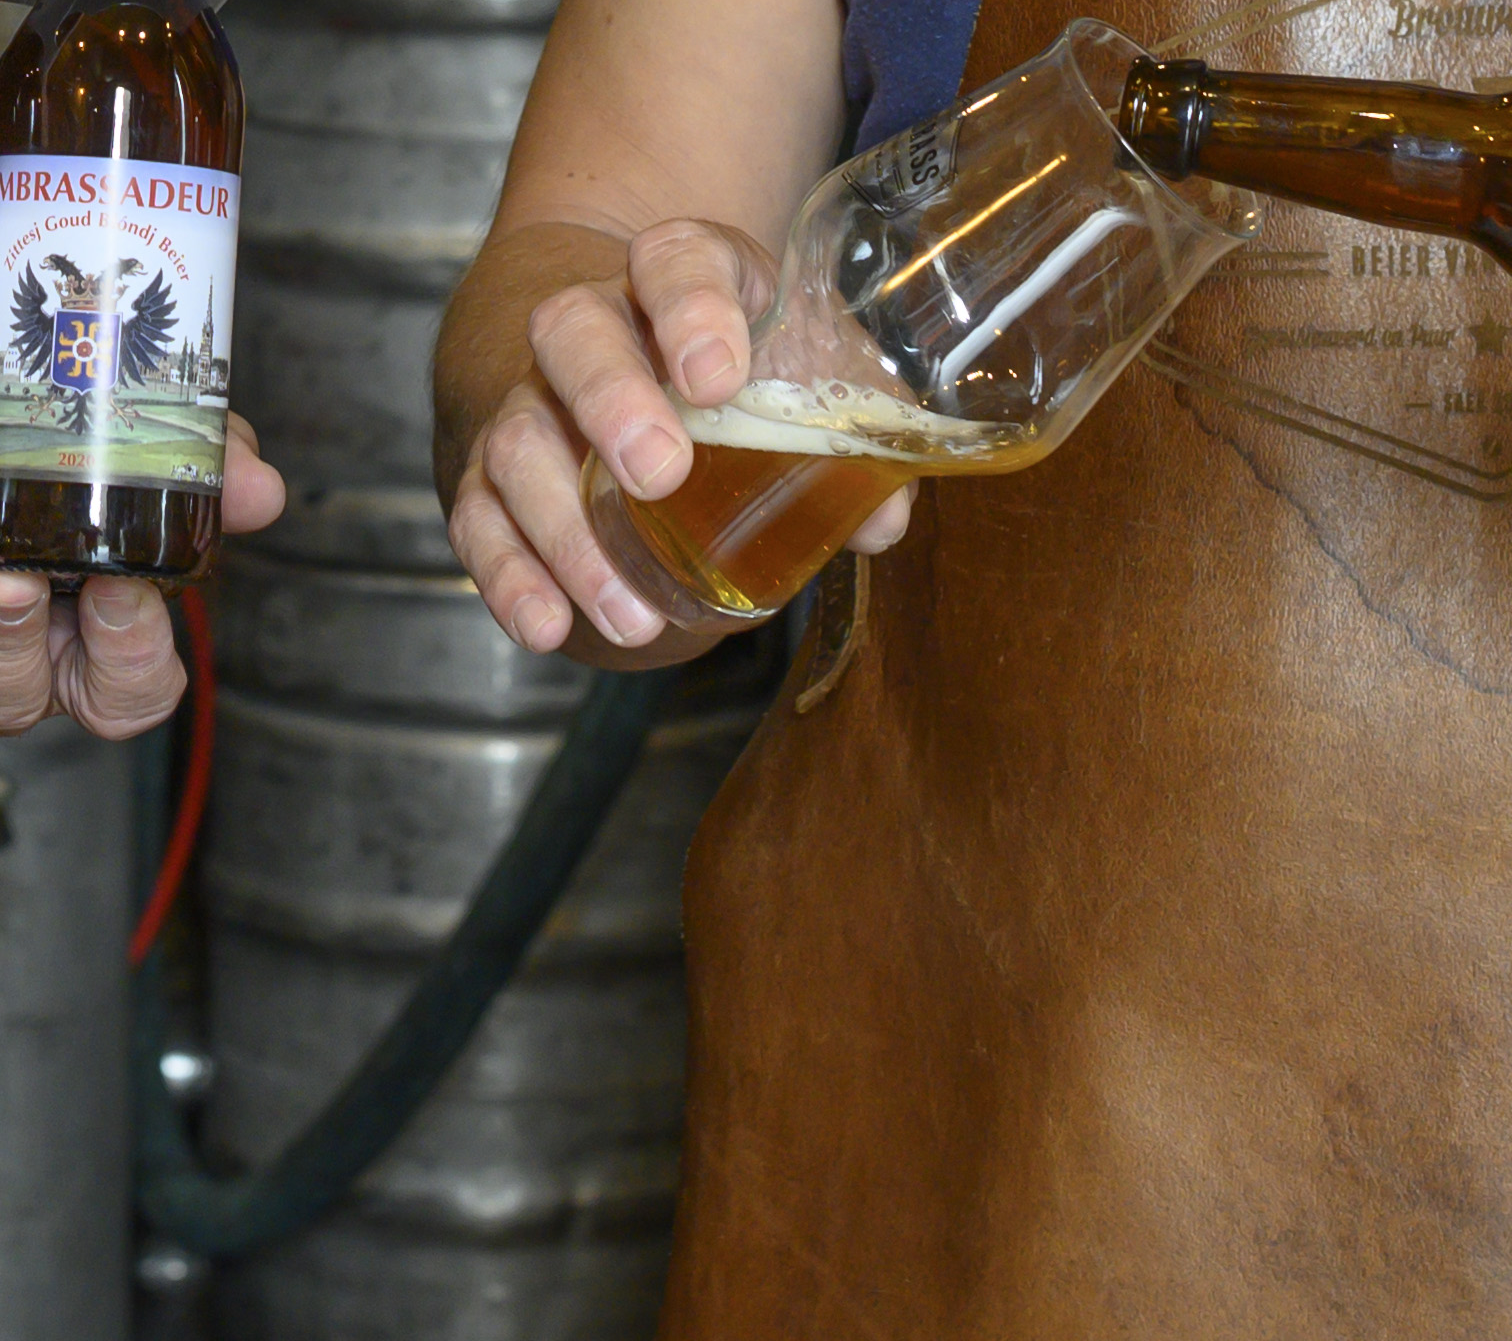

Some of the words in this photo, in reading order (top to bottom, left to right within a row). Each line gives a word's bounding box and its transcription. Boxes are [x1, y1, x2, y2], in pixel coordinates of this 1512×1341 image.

[4, 221, 42, 272] Zittesj
[44, 210, 91, 232] Goud
[158, 236, 190, 282] Beier
[57, 450, 96, 469] 2020
